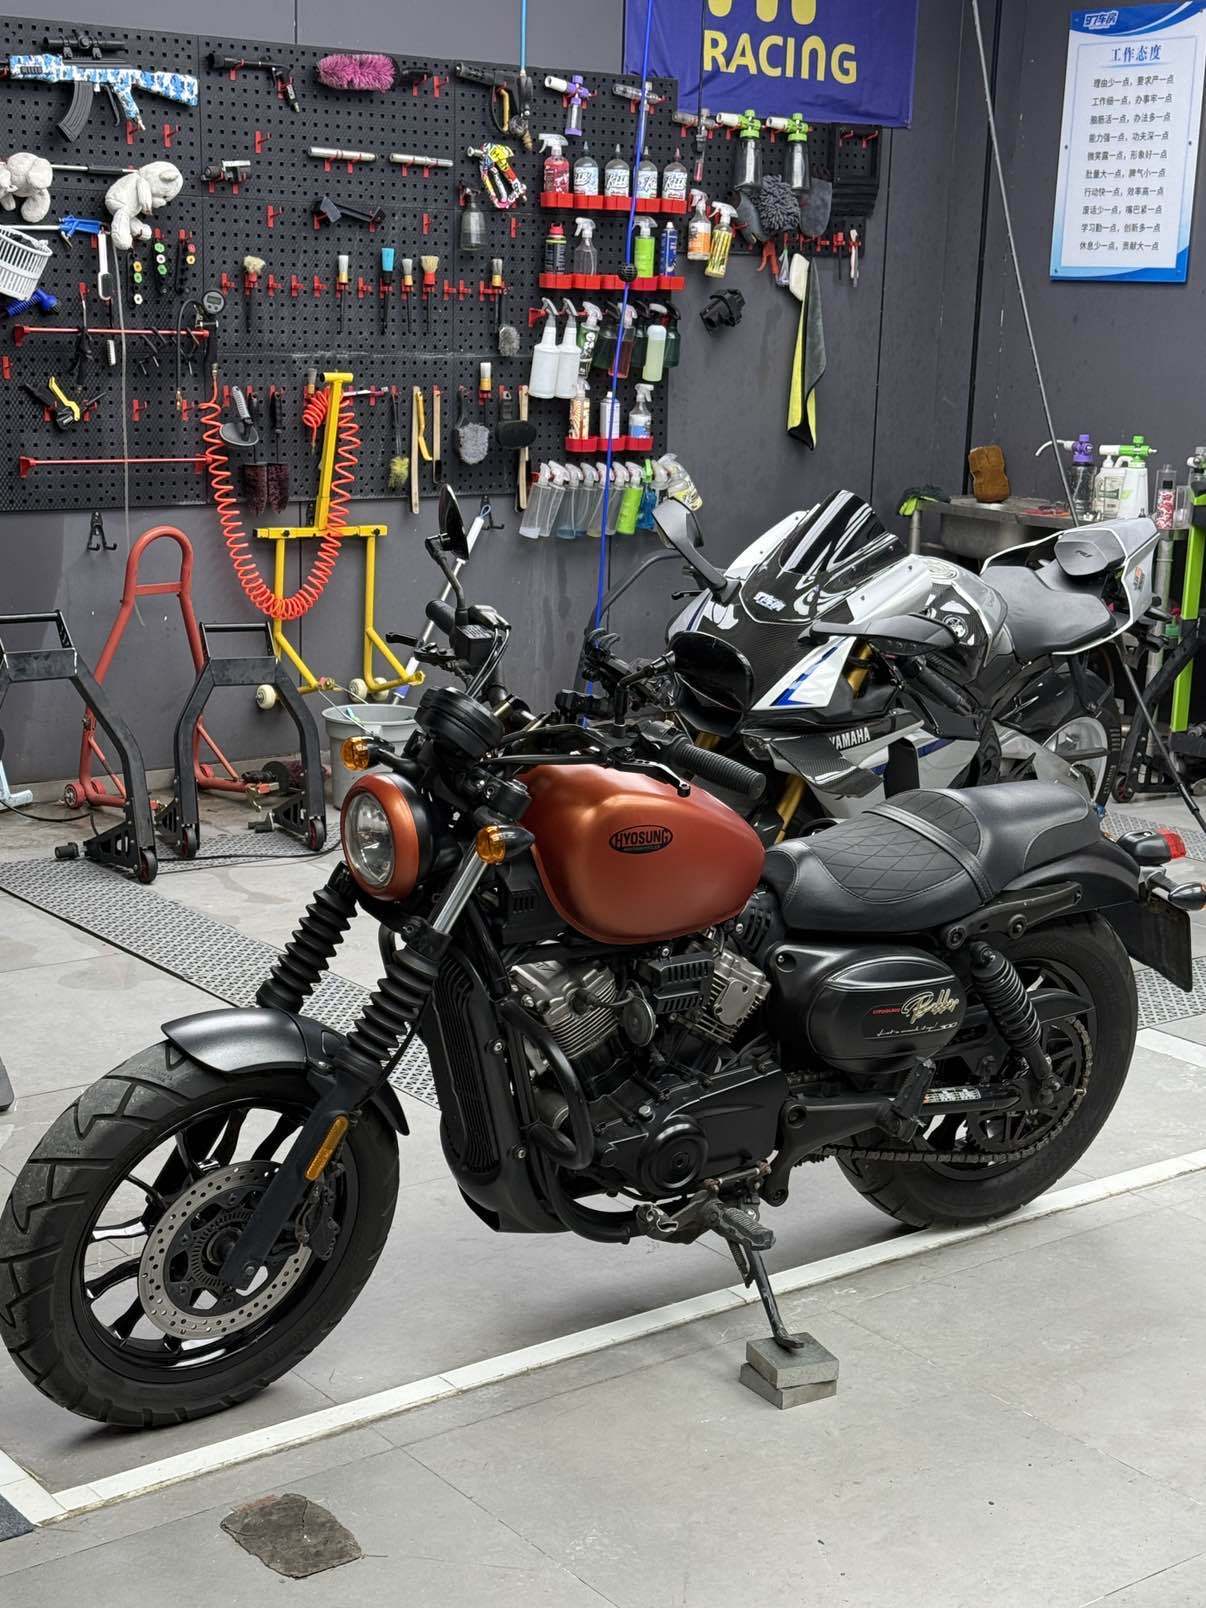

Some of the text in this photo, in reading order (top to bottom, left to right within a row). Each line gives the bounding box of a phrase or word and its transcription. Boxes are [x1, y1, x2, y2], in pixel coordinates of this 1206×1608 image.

[703, 29, 857, 84] RACING
[1111, 45, 1161, 62] 工作态度
[829, 726, 870, 750] YAMAHA
[614, 828, 669, 849] HYOSUNG
